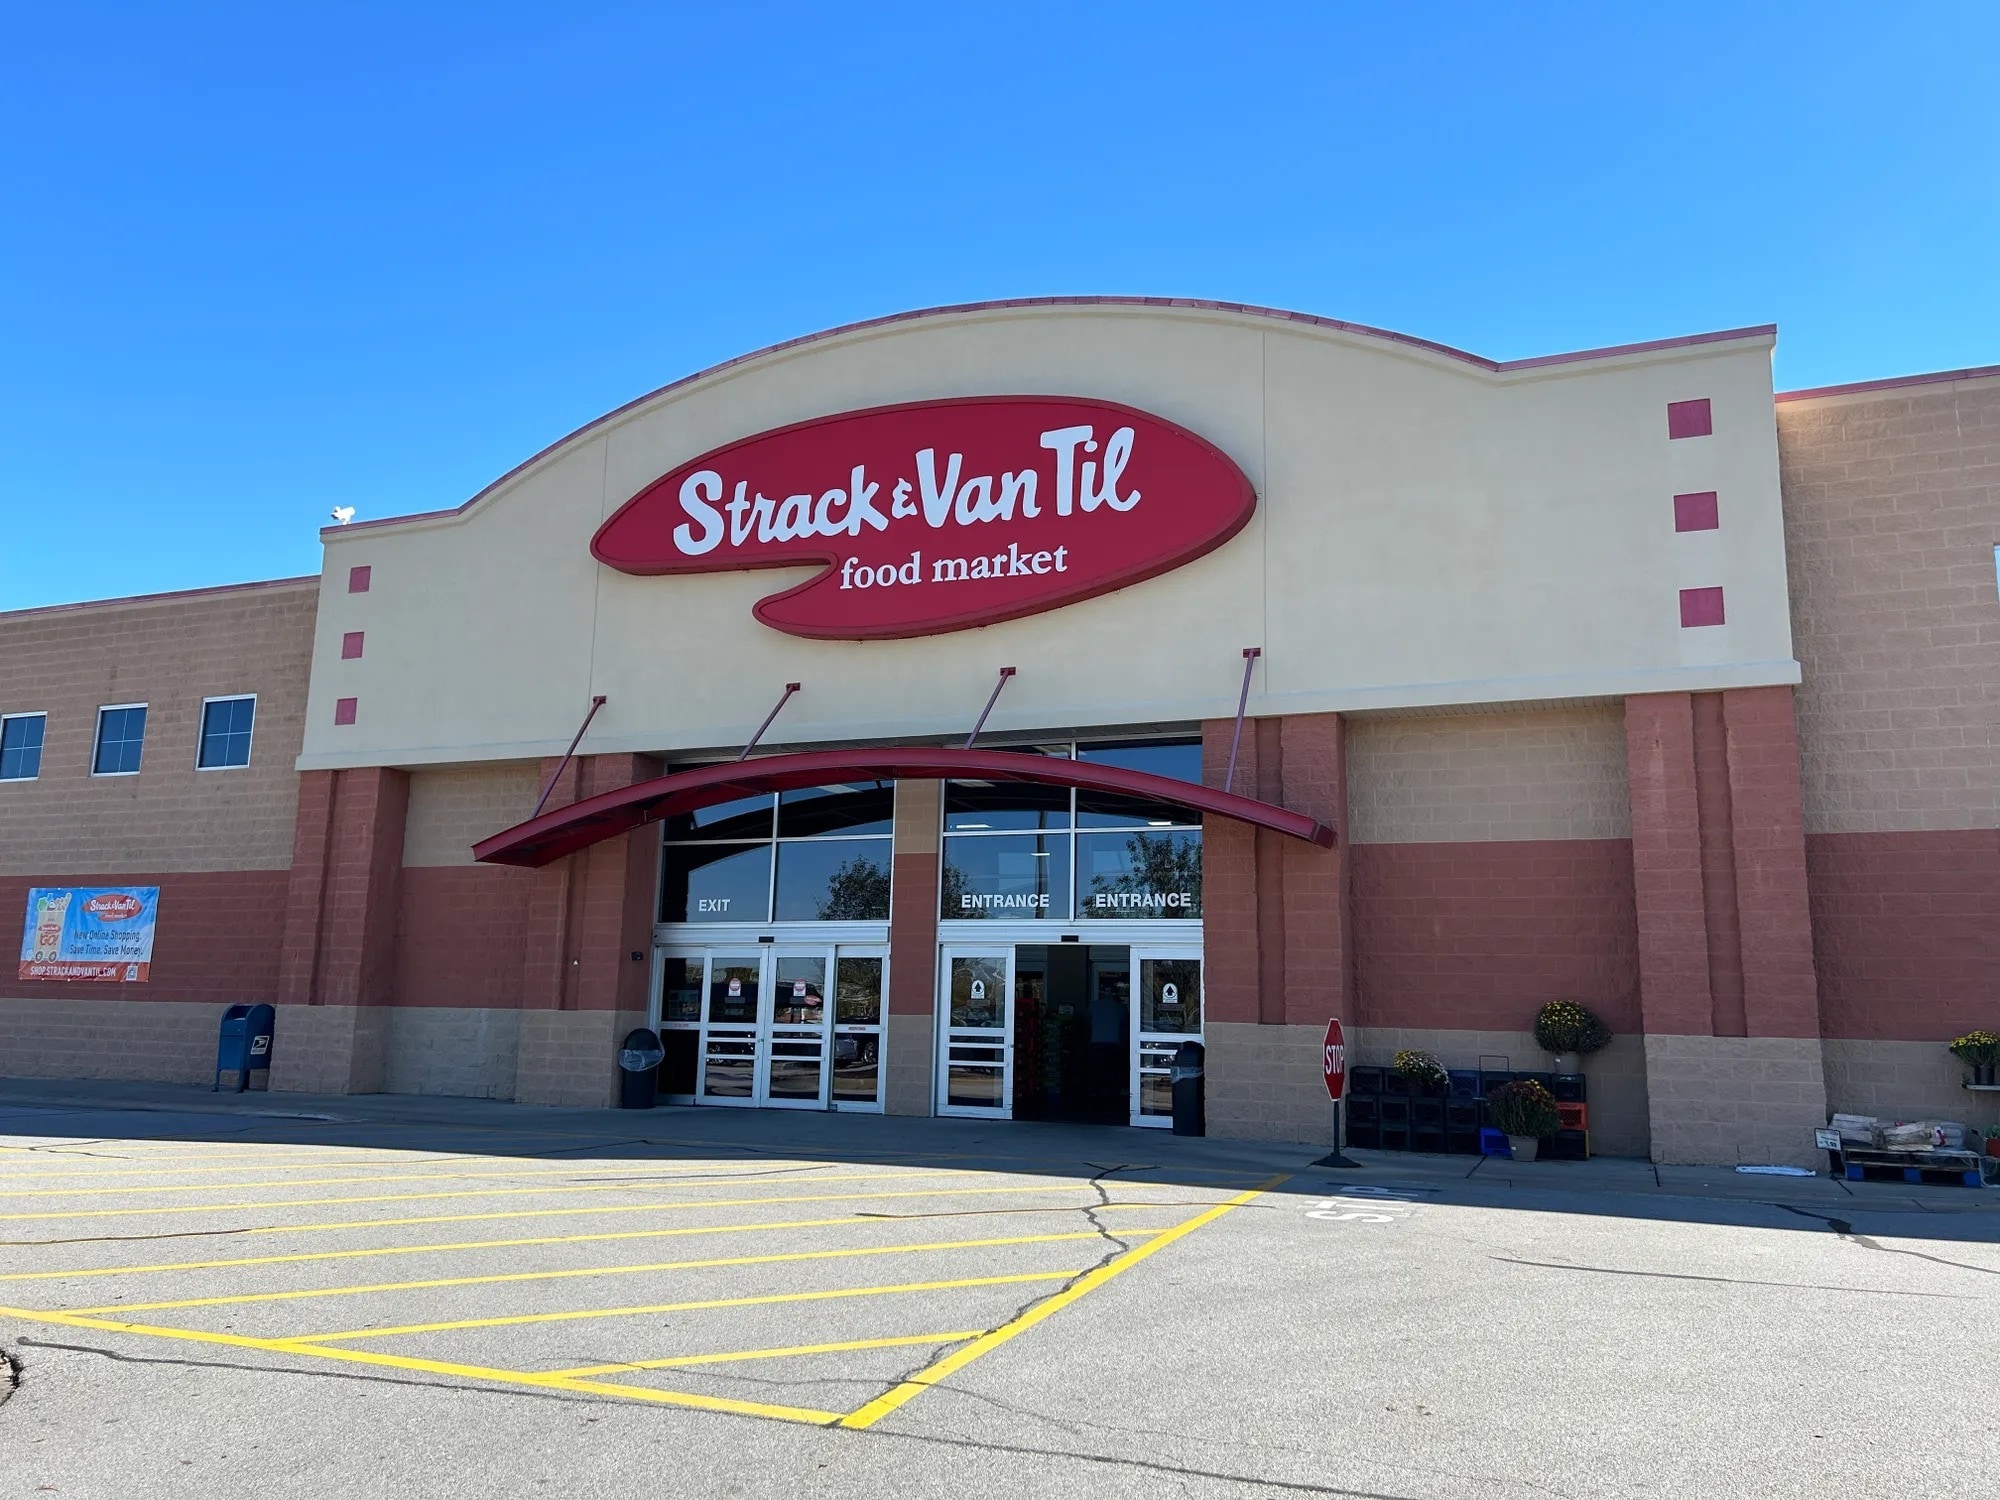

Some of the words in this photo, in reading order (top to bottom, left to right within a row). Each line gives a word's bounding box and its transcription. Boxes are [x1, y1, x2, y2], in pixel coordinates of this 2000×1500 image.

[674, 465, 888, 555] Strack
[892, 478, 917, 518] &
[915, 448, 1041, 528] Van
[1041, 425, 1141, 517] Til
[839, 551, 922, 590] food
[931, 543, 1069, 583] market
[90, 899, 112, 911] Strack
[114, 899, 126, 910] Van
[125, 899, 136, 910] Til
[698, 898, 731, 912] EXIT
[961, 893, 1050, 909] ENTRANCE
[1095, 892, 1192, 908] ENTRANCE
[89, 930, 110, 940] Online
[69, 944, 85, 955] Save
[103, 944, 119, 955] Save
[1325, 1044, 1344, 1075] STOP
